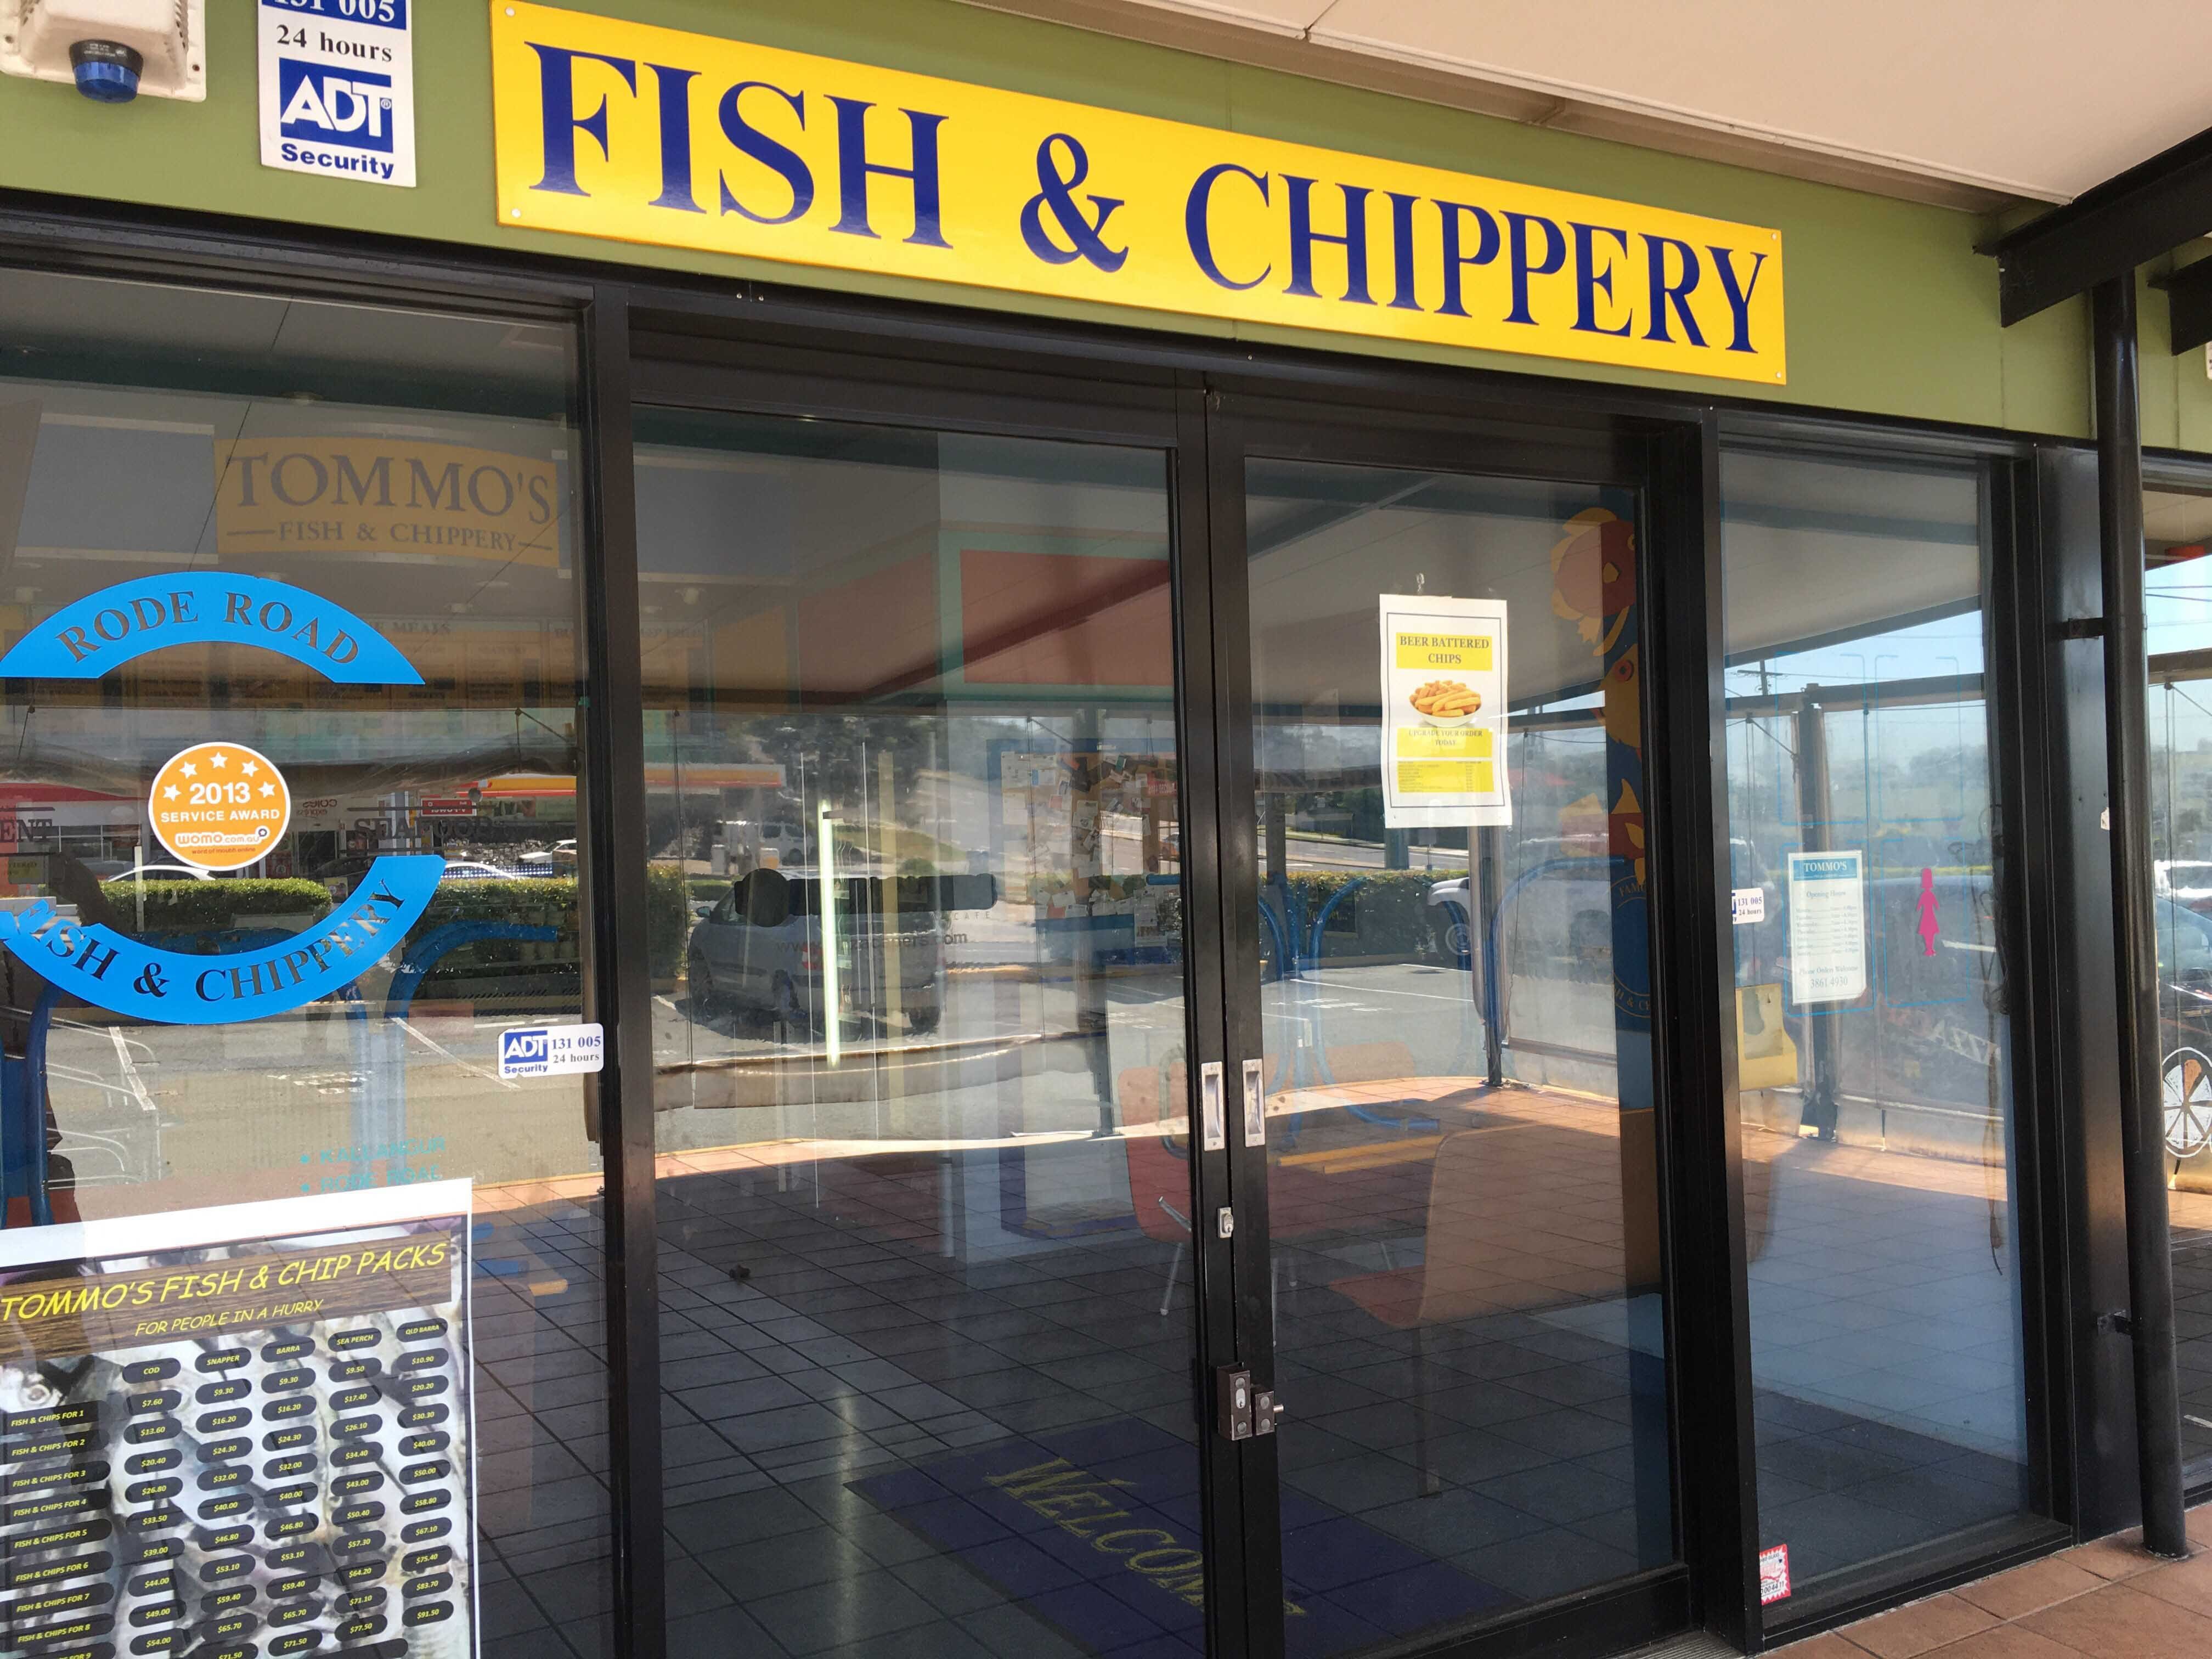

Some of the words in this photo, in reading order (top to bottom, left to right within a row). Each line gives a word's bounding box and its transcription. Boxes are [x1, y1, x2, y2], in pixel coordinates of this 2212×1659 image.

[276, 24, 307, 48] 24
[320, 31, 392, 62] hours
[281, 143, 394, 179] Security
[524, 41, 953, 250] FISH
[1020, 133, 1128, 273] &
[1185, 163, 1768, 354] CHIPPERY
[225, 452, 550, 526] TOMMO'S
[279, 520, 343, 542] FISH
[357, 524, 376, 541] &
[390, 524, 517, 551] CHIPPERY
[55, 590, 199, 663] RODE
[222, 591, 359, 665] ROAD
[1400, 635, 1429, 647] BEER
[1431, 636, 1489, 649] BATTERED
[1428, 653, 1462, 664] CHIPS
[189, 782, 251, 805] 2013
[161, 810, 224, 823] SERVICE
[229, 809, 280, 821] AWARD
[1803, 860, 1847, 872] TOMMO'S
[1738, 898, 1748, 906] 131
[133, 961, 170, 998] &
[195, 876, 405, 1003] CHIPPERY
[1810, 979, 1827, 988] 3861
[551, 1039, 572, 1050] 131
[578, 1036, 601, 1048] 005
[553, 1054, 566, 1064] 24
[570, 1052, 600, 1063] hours
[504, 1064, 548, 1074] Security
[320, 1137, 446, 1164] KALLANGUR
[321, 1173, 377, 1193] RODE
[1, 1282, 155, 1321] TOMMO'S
[160, 1268, 244, 1302] FISH
[250, 1265, 268, 1289] &
[278, 1254, 351, 1285] CHIP
[357, 1243, 447, 1274] PACKS
[136, 1321, 167, 1337] FOR
[171, 1312, 229, 1331] PEOPLE
[232, 1308, 254, 1323] IN
[257, 1307, 268, 1318] A
[272, 1299, 324, 1318] HURRY
[419, 1324, 439, 1333] BARRA
[351, 1335, 373, 1343] PERCH
[276, 1345, 300, 1355] BARRA
[206, 1355, 240, 1365] SNAPPER
[412, 1356, 435, 1364] $10.90
[346, 1366, 365, 1375] $9.50
[279, 1377, 298, 1386] $9.30
[214, 1387, 234, 1396] $9.30
[412, 1383, 435, 1392] $20.20
[142, 1398, 162, 1408] $7.60
[345, 1393, 367, 1403] $17.40
[278, 1404, 301, 1414] $16.20
[38, 1414, 60, 1423] CHIPS
[212, 1415, 237, 1425] $16.20
[413, 1411, 435, 1421] $30.30
[140, 1426, 165, 1436] $13.60
[345, 1422, 367, 1432] $26.10
[278, 1434, 301, 1444] $24.30
[39, 1443, 61, 1452] CHIPS
[414, 1440, 436, 1449] $40.00
[213, 1445, 237, 1455] $24.30
[345, 1450, 369, 1459] $34.40
[142, 1457, 166, 1467] $20.40
[279, 1462, 302, 1472] $32.00
[414, 1467, 436, 1477] $50.00
[40, 1474, 61, 1482] CHIPS
[213, 1473, 237, 1483] $32.00
[346, 1479, 369, 1489] $43.00
[142, 1486, 167, 1496] $26.80
[279, 1491, 302, 1501] $40.00
[41, 1503, 63, 1512] CHIPS
[64, 1500, 80, 1508] FOR
[214, 1502, 238, 1512] $40.00
[415, 1498, 437, 1508] $58.80
[347, 1509, 370, 1520] $50.40
[143, 1515, 167, 1525] $33.50
[280, 1522, 304, 1532] $46.80
[416, 1526, 438, 1536] $67.10
[42, 1534, 64, 1543] CHIPS
[215, 1533, 239, 1544] $46.80
[348, 1538, 371, 1549] $57.30
[144, 1547, 168, 1557] $39.00
[281, 1551, 304, 1561] $53.10
[416, 1554, 438, 1564] $75.40
[43, 1568, 65, 1577] CHIPS
[216, 1564, 239, 1575] $53.10
[349, 1568, 372, 1578] $64.20
[145, 1577, 170, 1588] $44.00
[282, 1581, 305, 1592] $59.40
[417, 1581, 439, 1591] $83.70
[43, 1599, 66, 1607] CHIPS
[217, 1593, 241, 1604] $59.40
[349, 1595, 372, 1606] $71.10
[145, 1609, 170, 1619] $49.00
[283, 1610, 307, 1620] $65.70
[417, 1609, 439, 1620] $91.50
[218, 1623, 242, 1634] $65.70
[350, 1623, 372, 1634] $77.50
[146, 1637, 171, 1648] $54.00
[284, 1638, 307, 1649] $71.50
